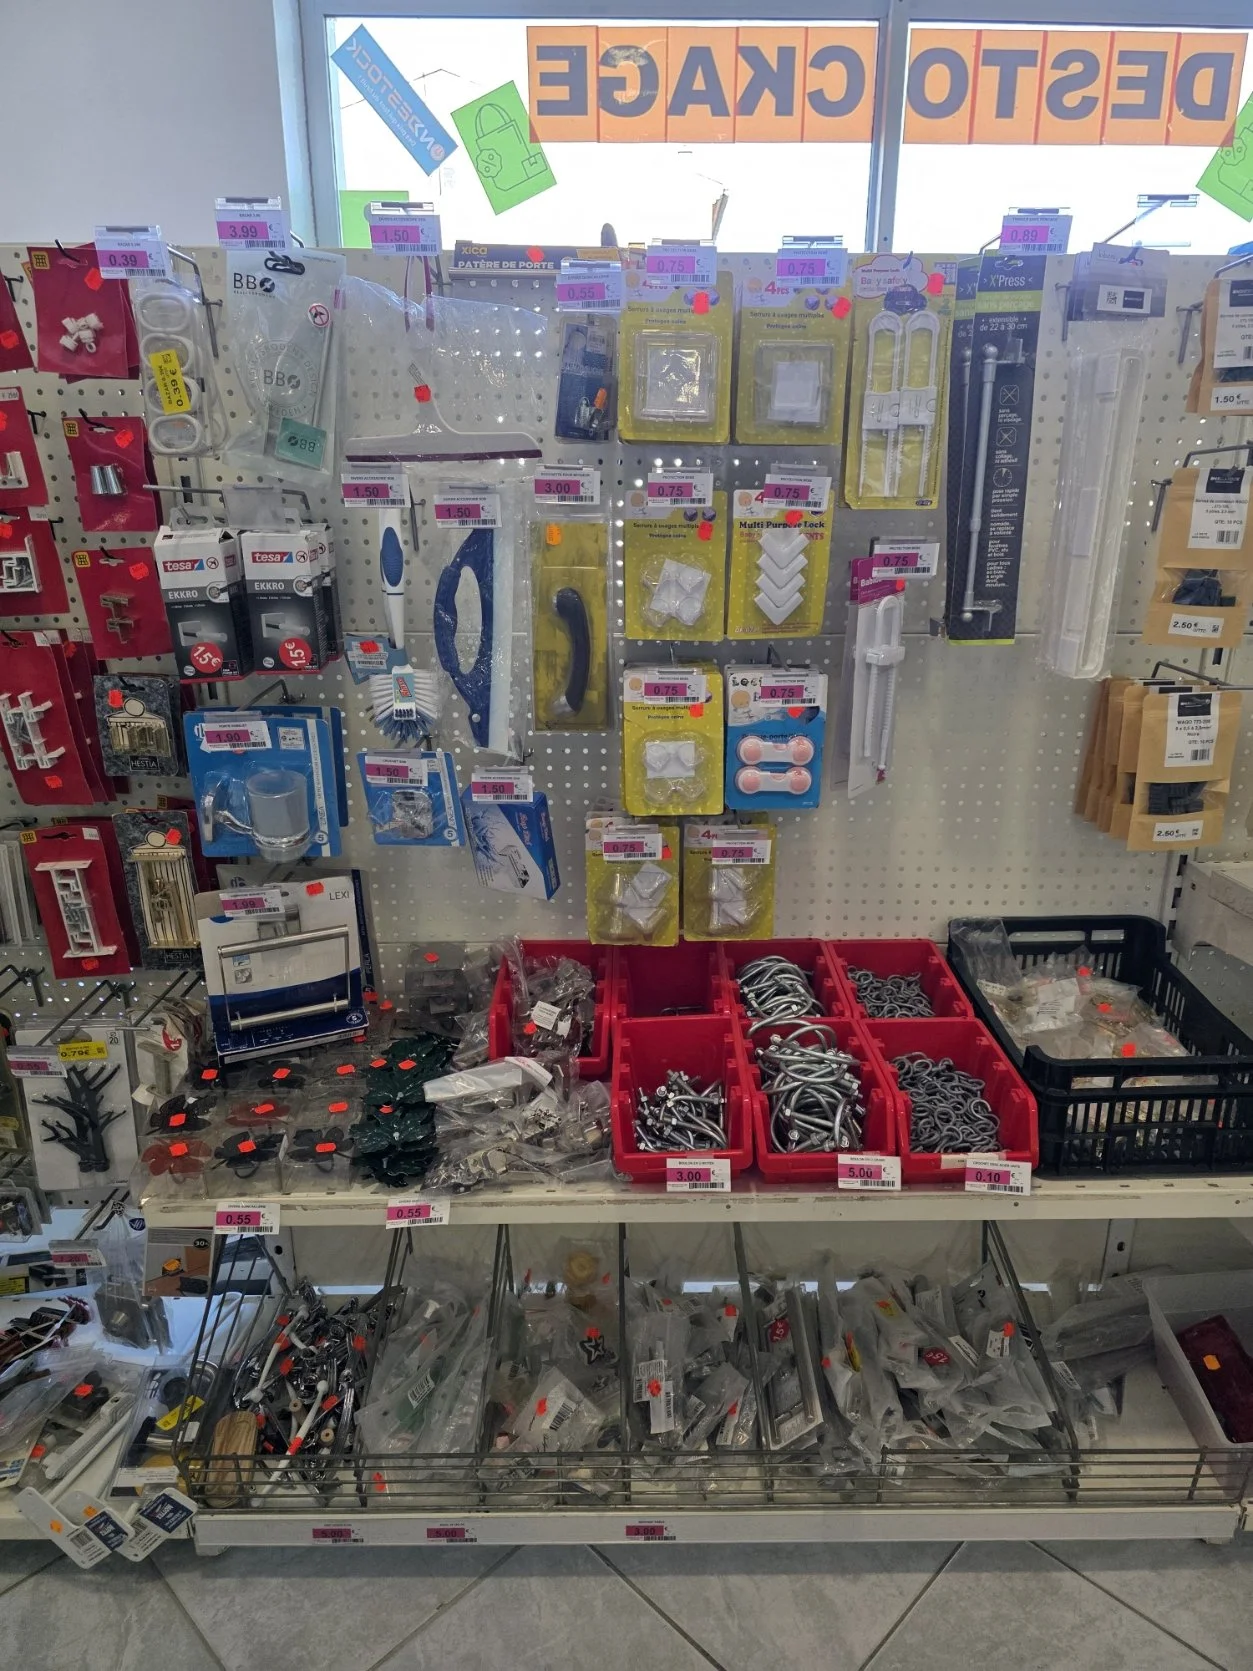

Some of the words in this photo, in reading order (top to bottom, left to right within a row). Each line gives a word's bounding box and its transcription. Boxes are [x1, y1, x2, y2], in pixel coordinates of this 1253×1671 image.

[229, 225, 258, 238] 3.99
[383, 229, 409, 242] 1.50
[1010, 229, 1038, 243] 0.89
[108, 254, 138, 267] 0.39
[458, 259, 498, 269] PATÈRE
[499, 260, 517, 269] DE
[518, 260, 554, 270] PORTE
[657, 259, 685, 273] 0.75
[787, 262, 815, 276] 0.75
[567, 286, 595, 300] 0.55
[990, 323, 999, 331] 22
[1007, 322, 1016, 330] 30
[1215, 395, 1235, 404] 1.50
[353, 487, 380, 498] 1.50
[544, 483, 571, 495] 3.00
[657, 486, 684, 498] 0.75
[774, 487, 800, 499] 0.75
[445, 507, 471, 519] 1.50
[739, 520, 764, 529] Multi
[804, 520, 825, 529] Lock
[253, 551, 281, 562] tesa
[883, 555, 909, 567] 0.75
[165, 561, 193, 571] tesa
[254, 581, 285, 591] EKKRO
[168, 590, 198, 600] EKKRO
[1173, 621, 1193, 629] 2.50
[653, 685, 679, 696] 0.75
[770, 688, 795, 698] 0.75
[215, 732, 241, 743] 1.90
[131, 759, 158, 769] HESTIA
[376, 766, 400, 777] 1.50
[481, 784, 505, 794] 1.50
[612, 843, 636, 853] 0.75
[721, 849, 745, 858] 0.75
[232, 900, 256, 910] 1.99
[676, 1171, 702, 1182] 3.00
[848, 1167, 873, 1178] 5.00
[975, 1171, 1000, 1182] 0.10
[396, 1207, 422, 1219] 0.55
[225, 1213, 252, 1225] 0.55
